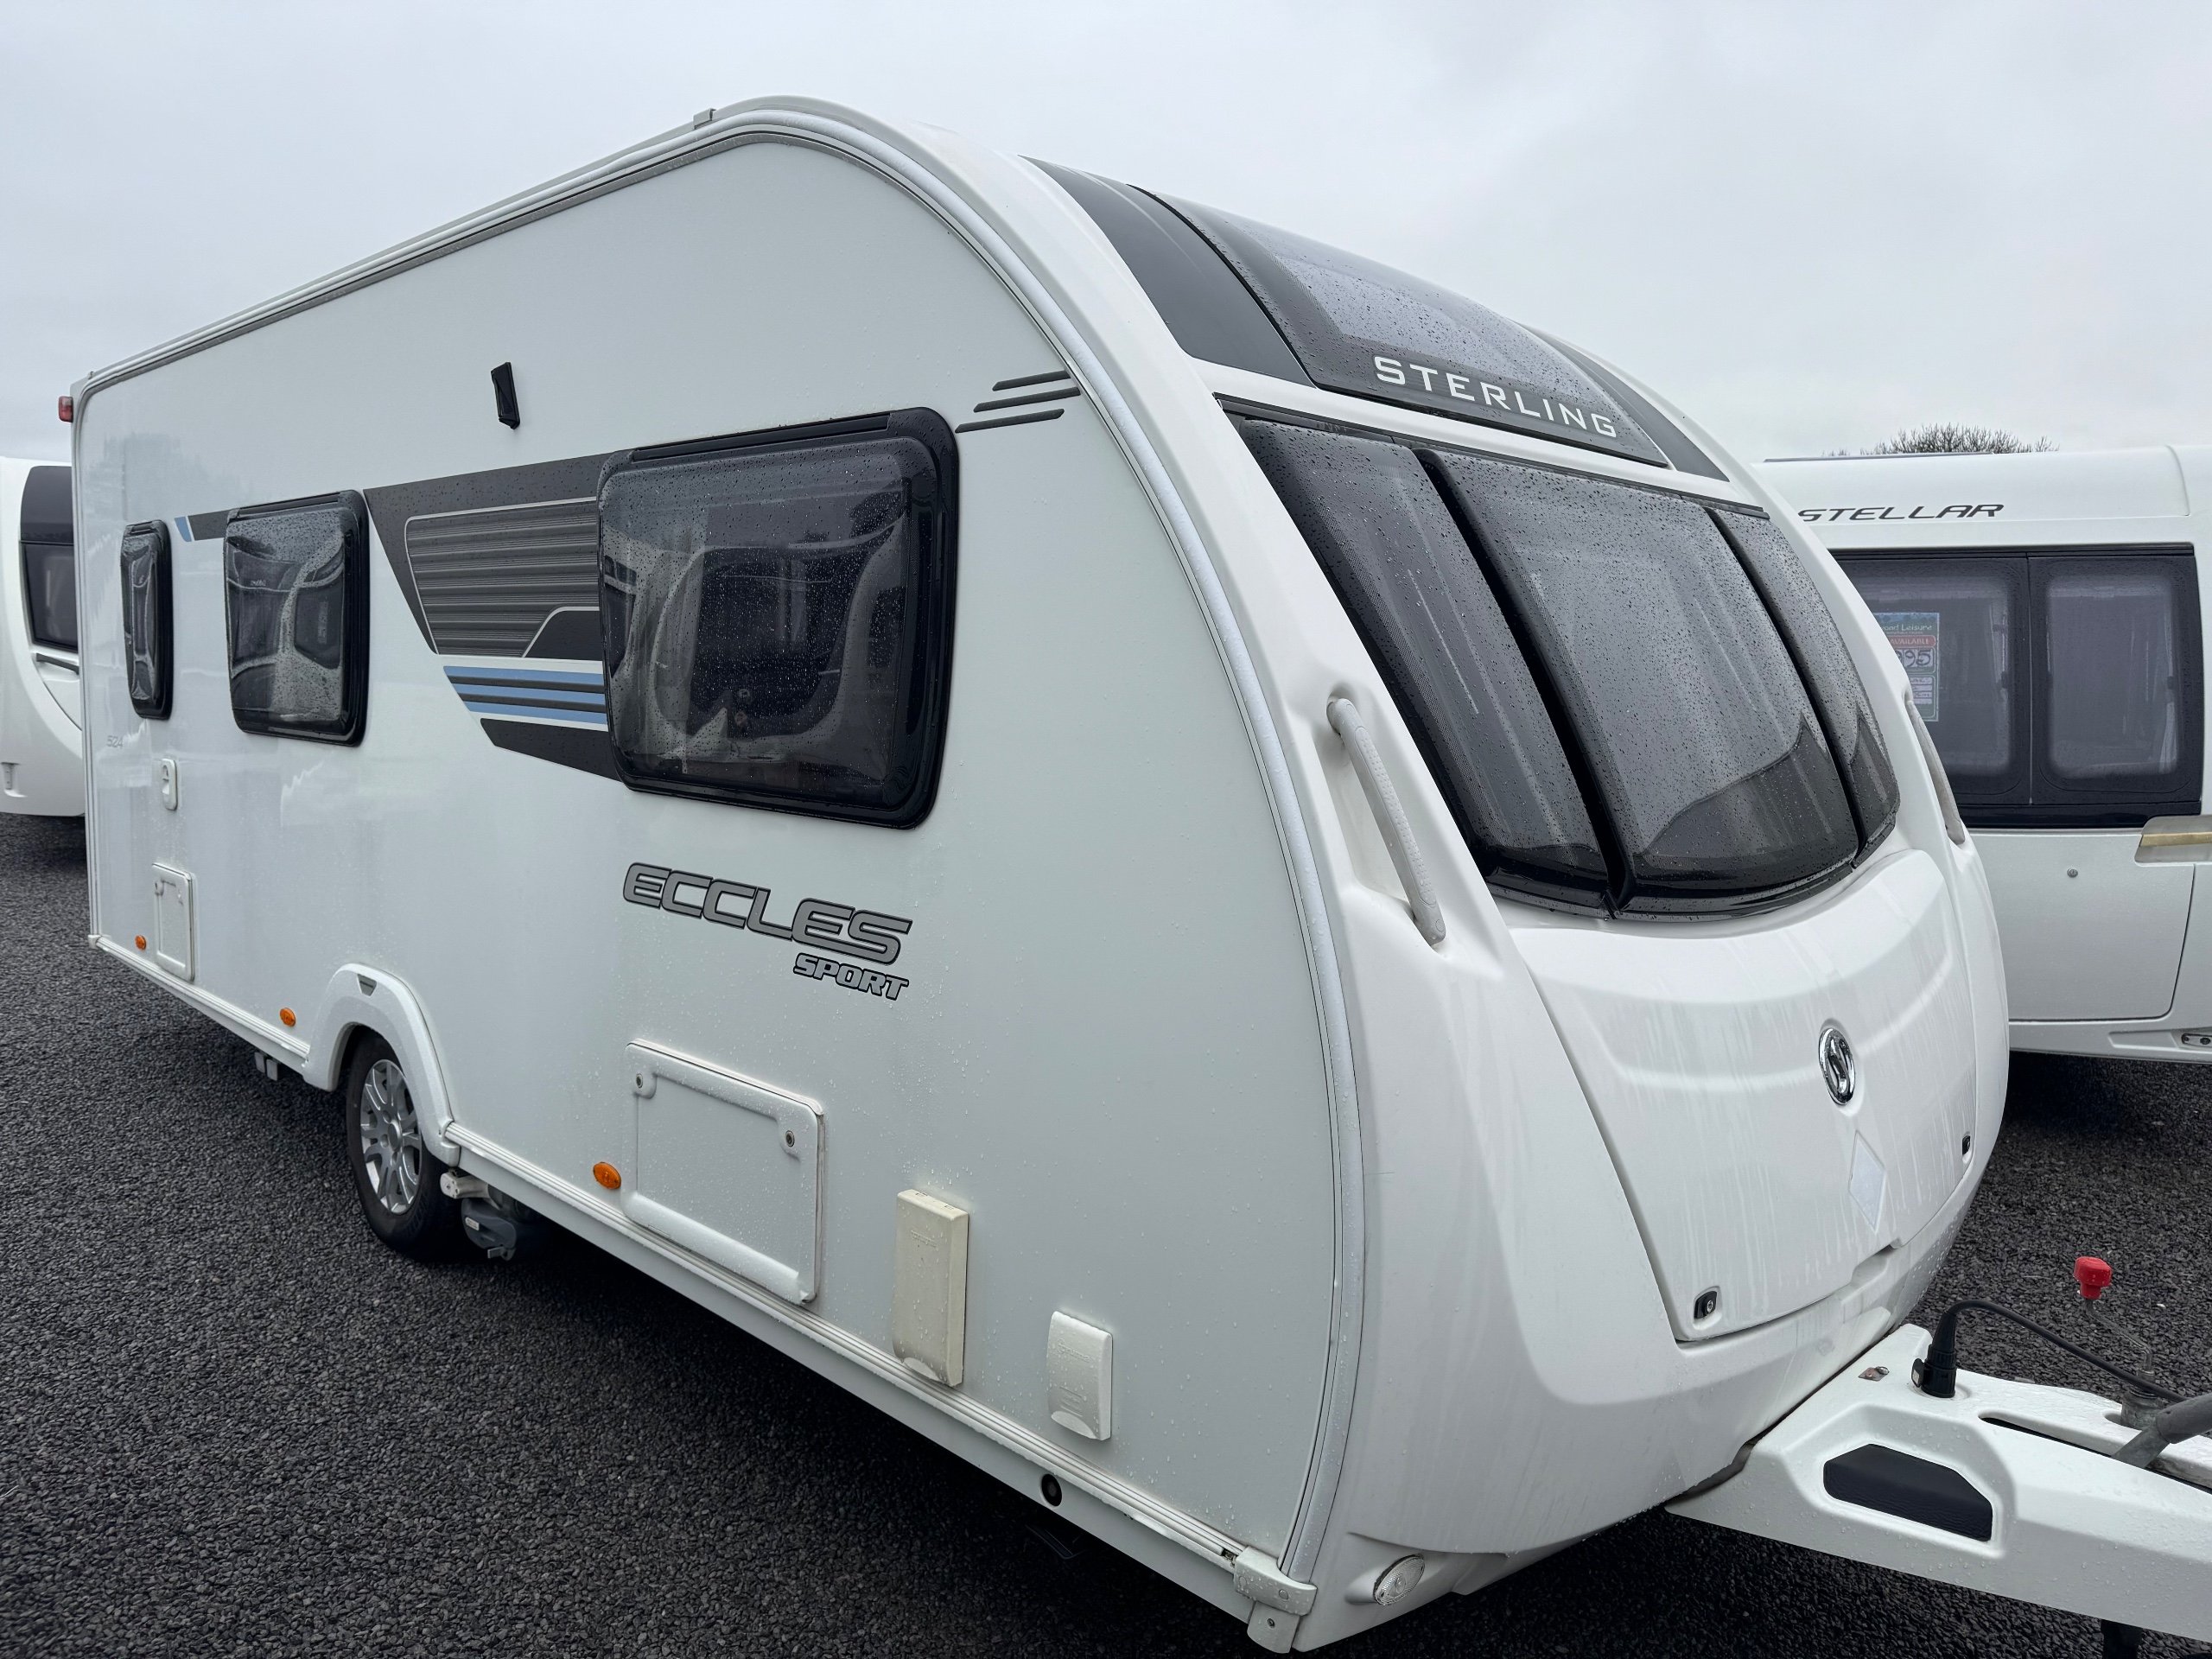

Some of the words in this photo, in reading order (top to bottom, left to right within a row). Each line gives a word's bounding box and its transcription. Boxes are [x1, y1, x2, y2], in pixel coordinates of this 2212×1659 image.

[1374, 356, 1617, 438] STERLING
[1798, 504, 2005, 522] STELLAR
[107, 734, 124, 749] 524
[623, 862, 912, 965] ECCLES
[793, 952, 909, 1001] SPORT
